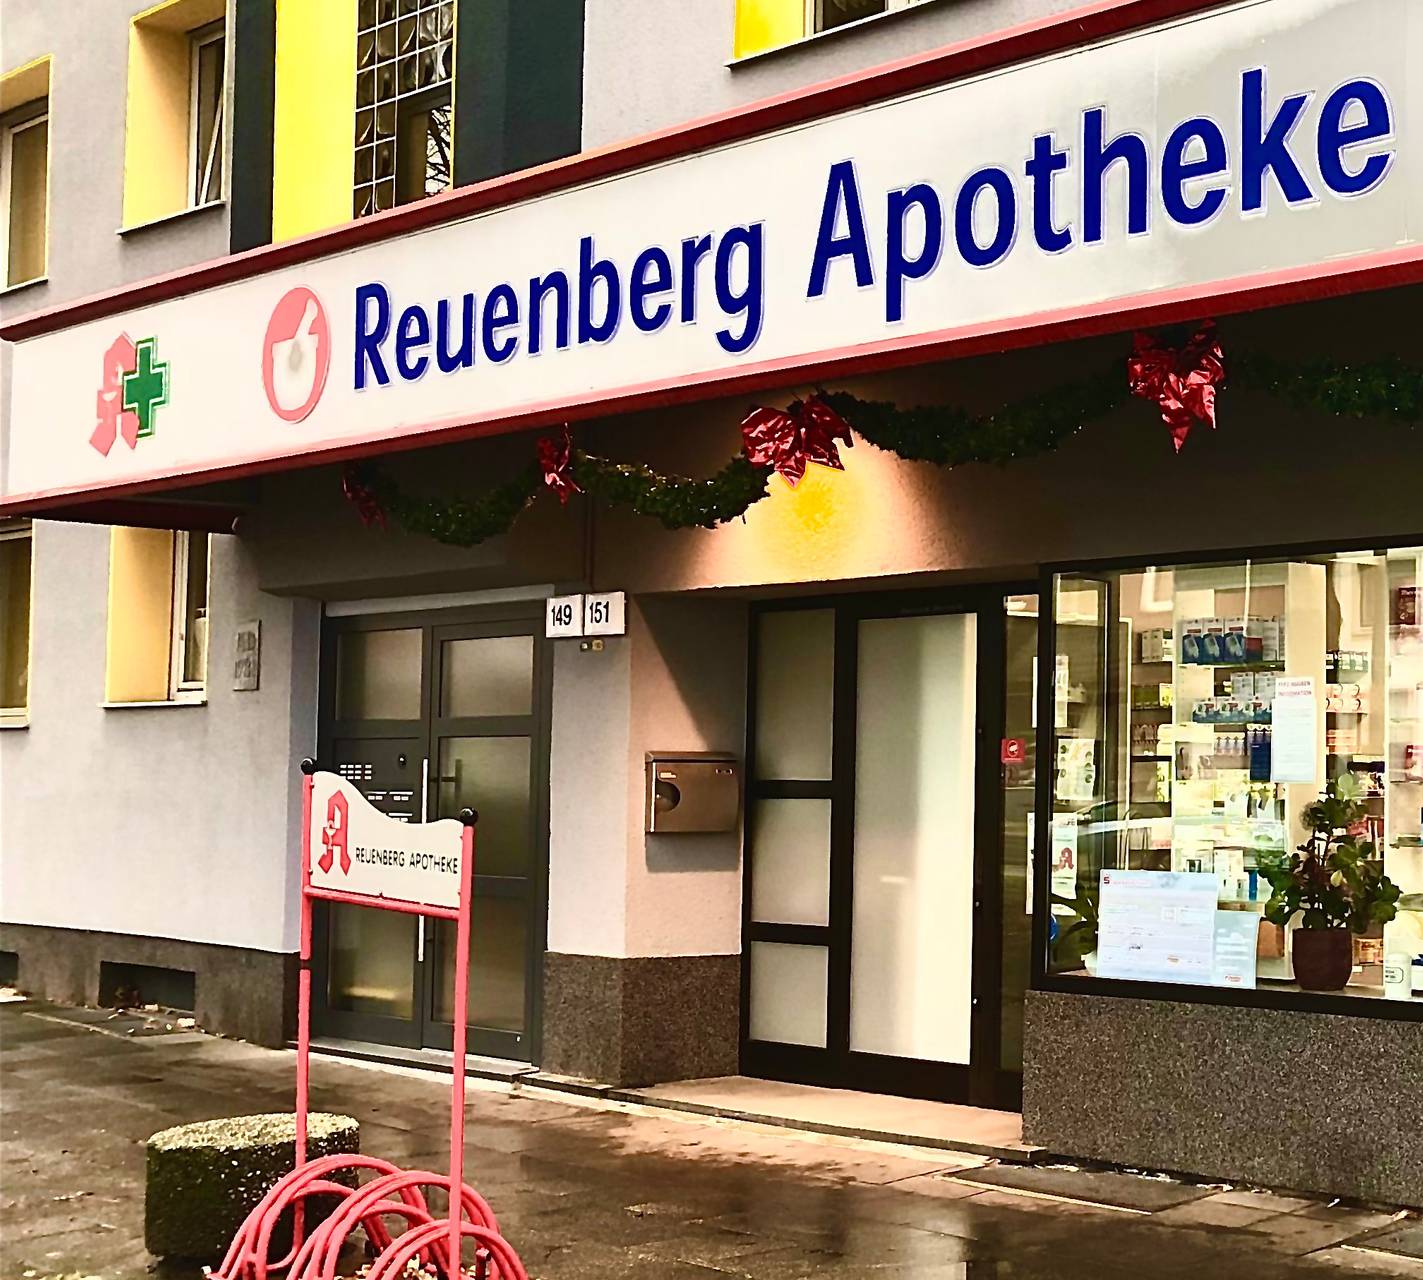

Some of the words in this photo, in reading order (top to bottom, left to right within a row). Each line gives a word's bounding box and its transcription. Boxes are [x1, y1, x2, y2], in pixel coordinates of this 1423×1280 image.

[354, 219, 766, 391] Reuenberg
[806, 65, 1396, 325] Apotheke
[551, 603, 573, 627] 149
[589, 600, 610, 624] 151
[355, 847, 405, 867] REUENBERG
[409, 852, 458, 874] APOTHEKE
